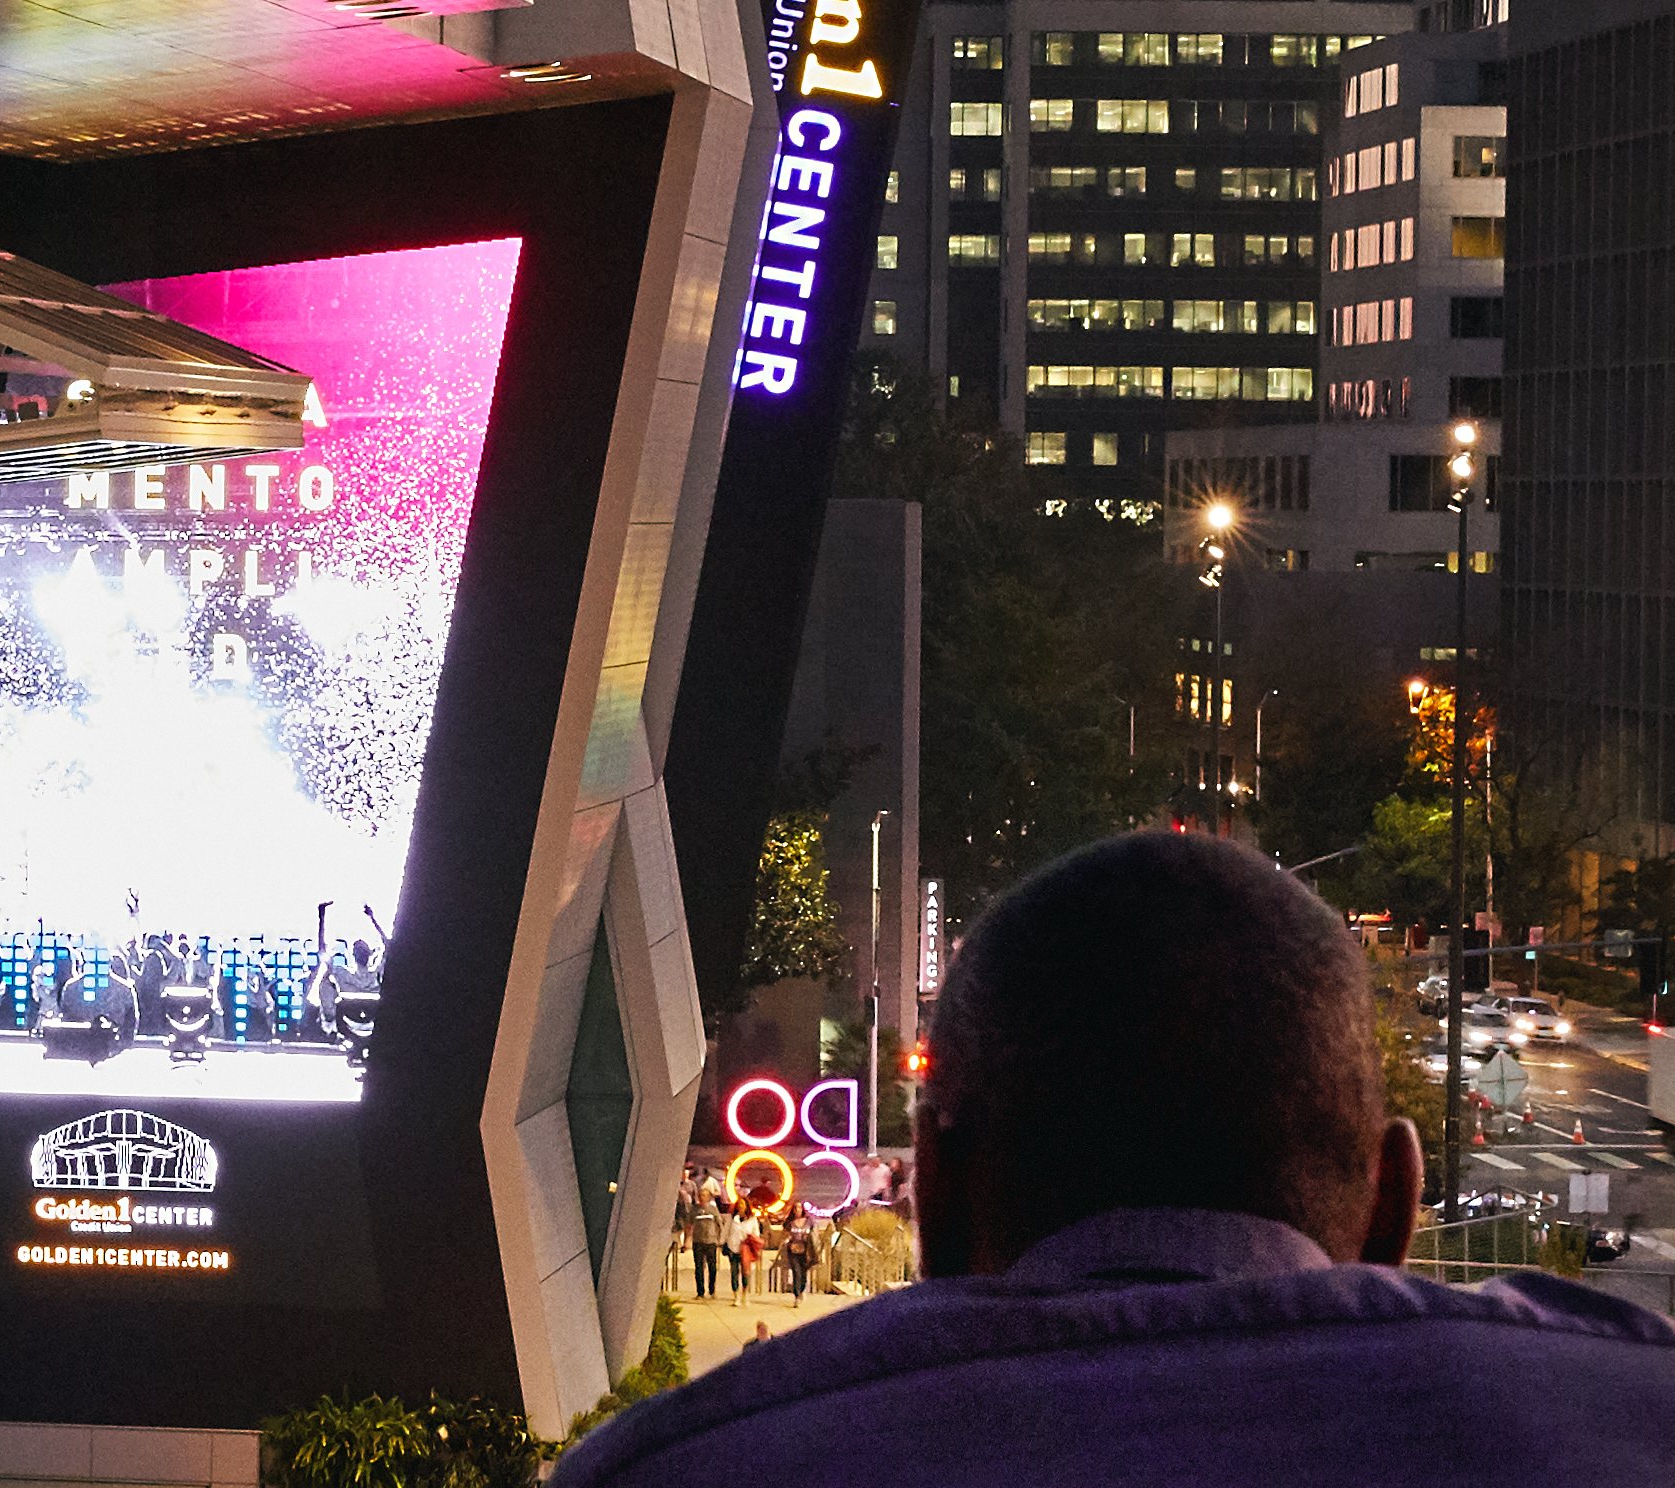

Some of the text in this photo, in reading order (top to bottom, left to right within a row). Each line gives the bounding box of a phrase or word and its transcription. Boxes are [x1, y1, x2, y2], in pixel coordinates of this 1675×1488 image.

[739, 109, 842, 397] CENTER
[926, 881, 939, 978] PARKING
[132, 1206, 214, 1226] CENTER
[17, 1245, 230, 1269] GOLDEN1CENTER.COM
